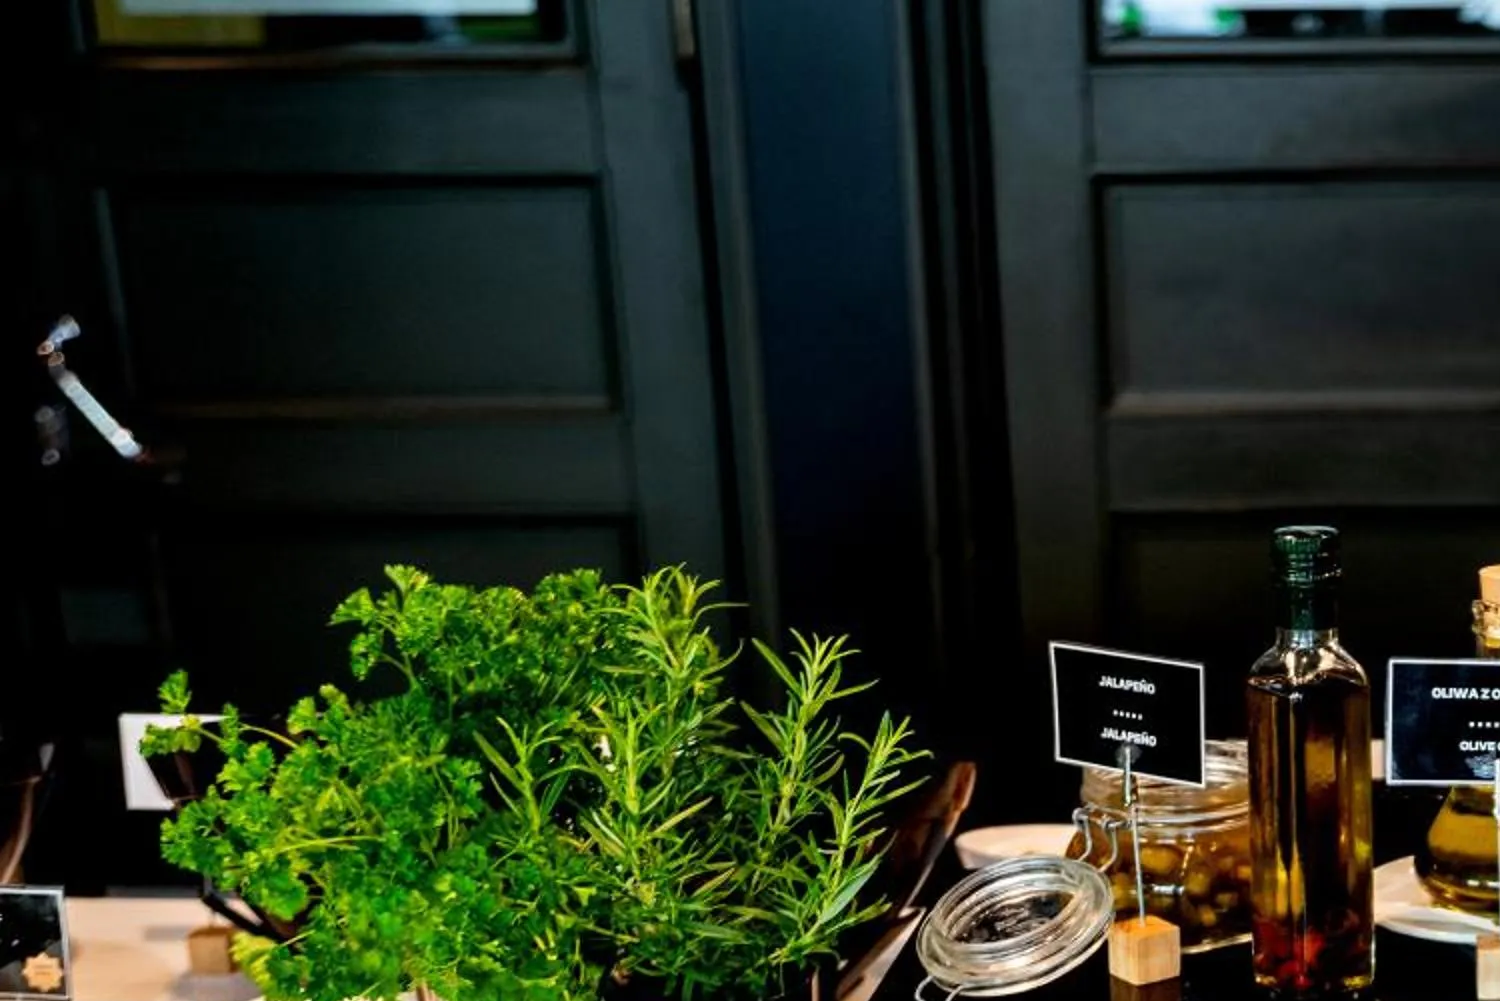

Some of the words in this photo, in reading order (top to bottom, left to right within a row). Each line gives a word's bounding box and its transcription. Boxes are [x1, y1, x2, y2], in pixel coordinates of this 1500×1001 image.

[1431, 686, 1479, 700] OLIWA
[1480, 687, 1490, 699] Z
[1459, 740, 1495, 751] OLIVE
